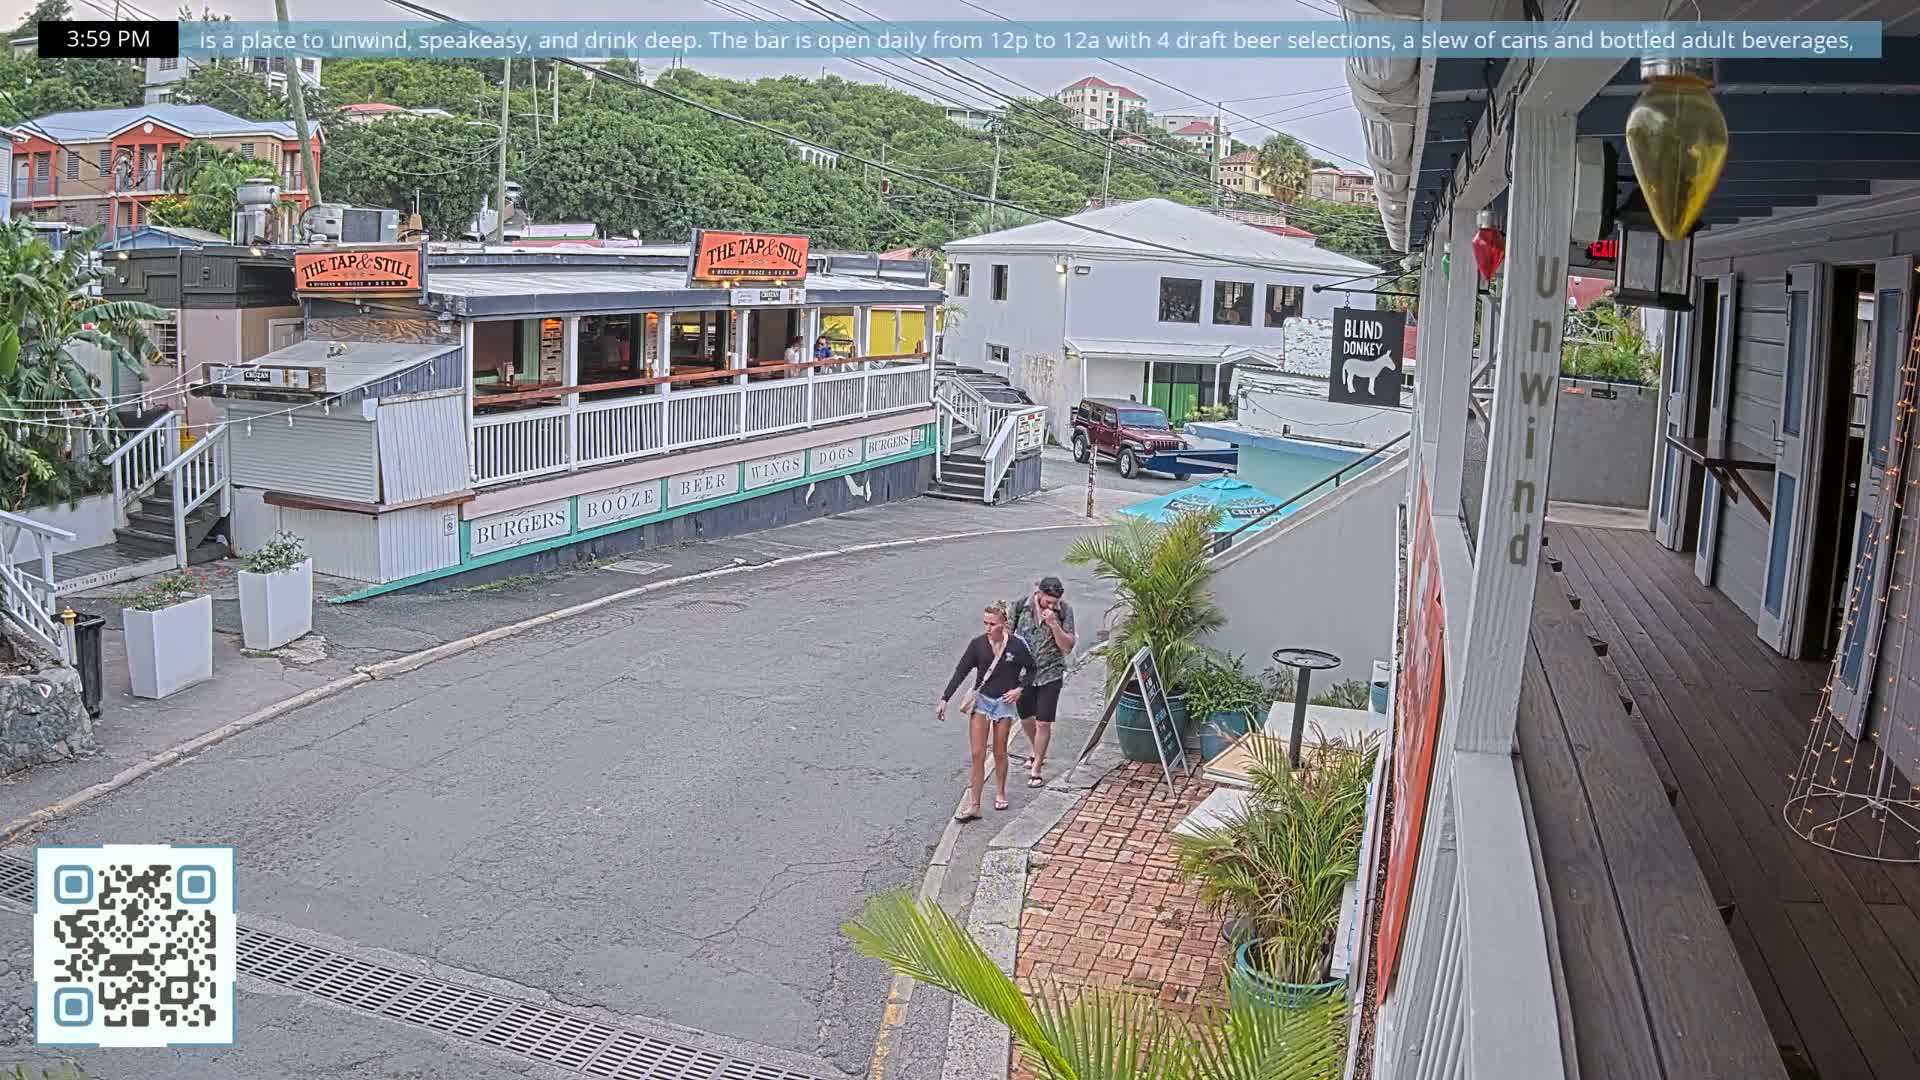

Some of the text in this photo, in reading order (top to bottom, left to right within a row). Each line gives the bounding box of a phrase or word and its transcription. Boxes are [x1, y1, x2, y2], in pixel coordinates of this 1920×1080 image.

[707, 238, 802, 268] THE TAP & STILL
[301, 253, 413, 280] THE TAP & STILL
[1344, 319, 1383, 340] BLIND
[1343, 340, 1383, 356] DONKEY
[244, 371, 269, 379] CRUZAN
[1509, 255, 1560, 567] Unwind
[868, 432, 910, 453] BURGERS
[819, 447, 855, 465] DOGS
[751, 459, 800, 480] WINGS
[681, 473, 726, 496] BEER
[587, 488, 654, 518] BOOZE
[476, 510, 565, 545] BURGERS
